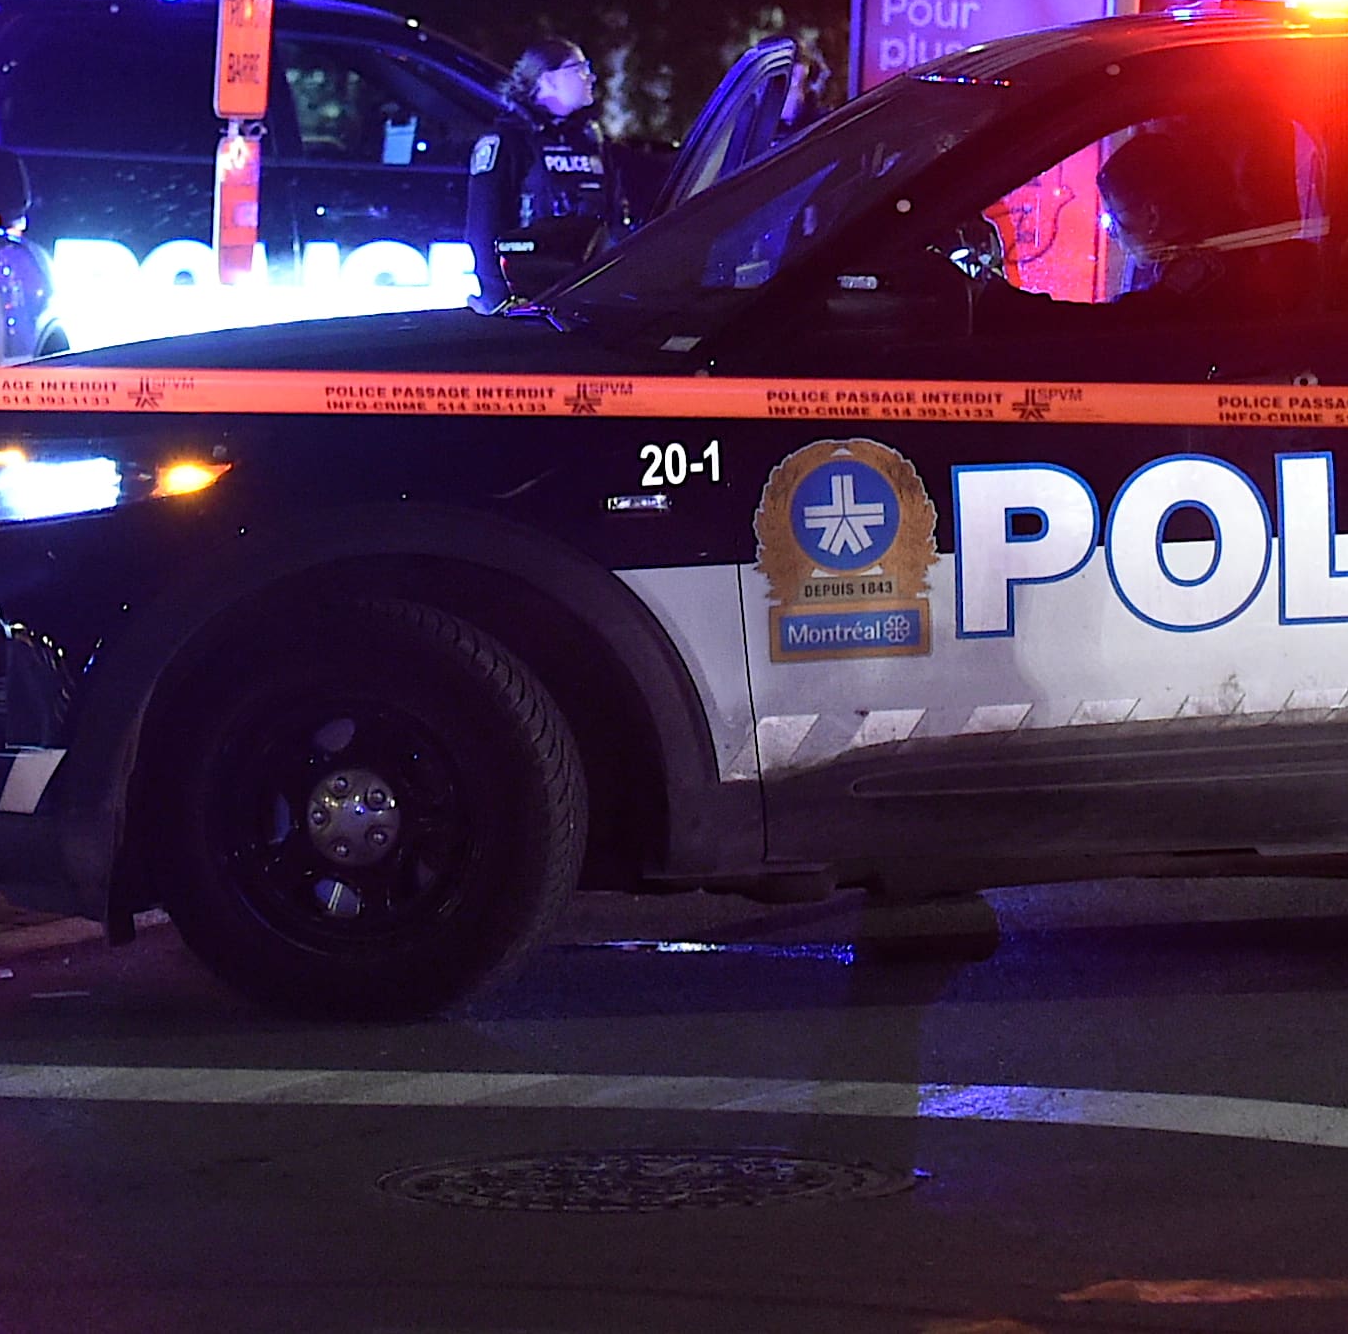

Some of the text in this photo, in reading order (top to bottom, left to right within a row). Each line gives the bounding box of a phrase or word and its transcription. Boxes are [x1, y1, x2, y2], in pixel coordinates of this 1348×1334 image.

[544, 154, 591, 173] POLICE
[40, 380, 118, 392] INTERDIT
[589, 383, 633, 396] SPVM
[325, 386, 555, 400] POLICE PASSAGE INTERDIT
[766, 390, 1003, 405] POLICE PASSAGE INTERDIT
[1037, 388, 1083, 401] SPVM
[327, 400, 428, 412] INFO-CRIME
[1218, 396, 1282, 409] POLICE
[768, 406, 870, 416] INFO-CRIME
[1219, 412, 1324, 423] INFO-CRIME
[639, 439, 720, 487] 20-1
[804, 580, 894, 598] DEPUIS 1843
[787, 619, 882, 645] Montréal
